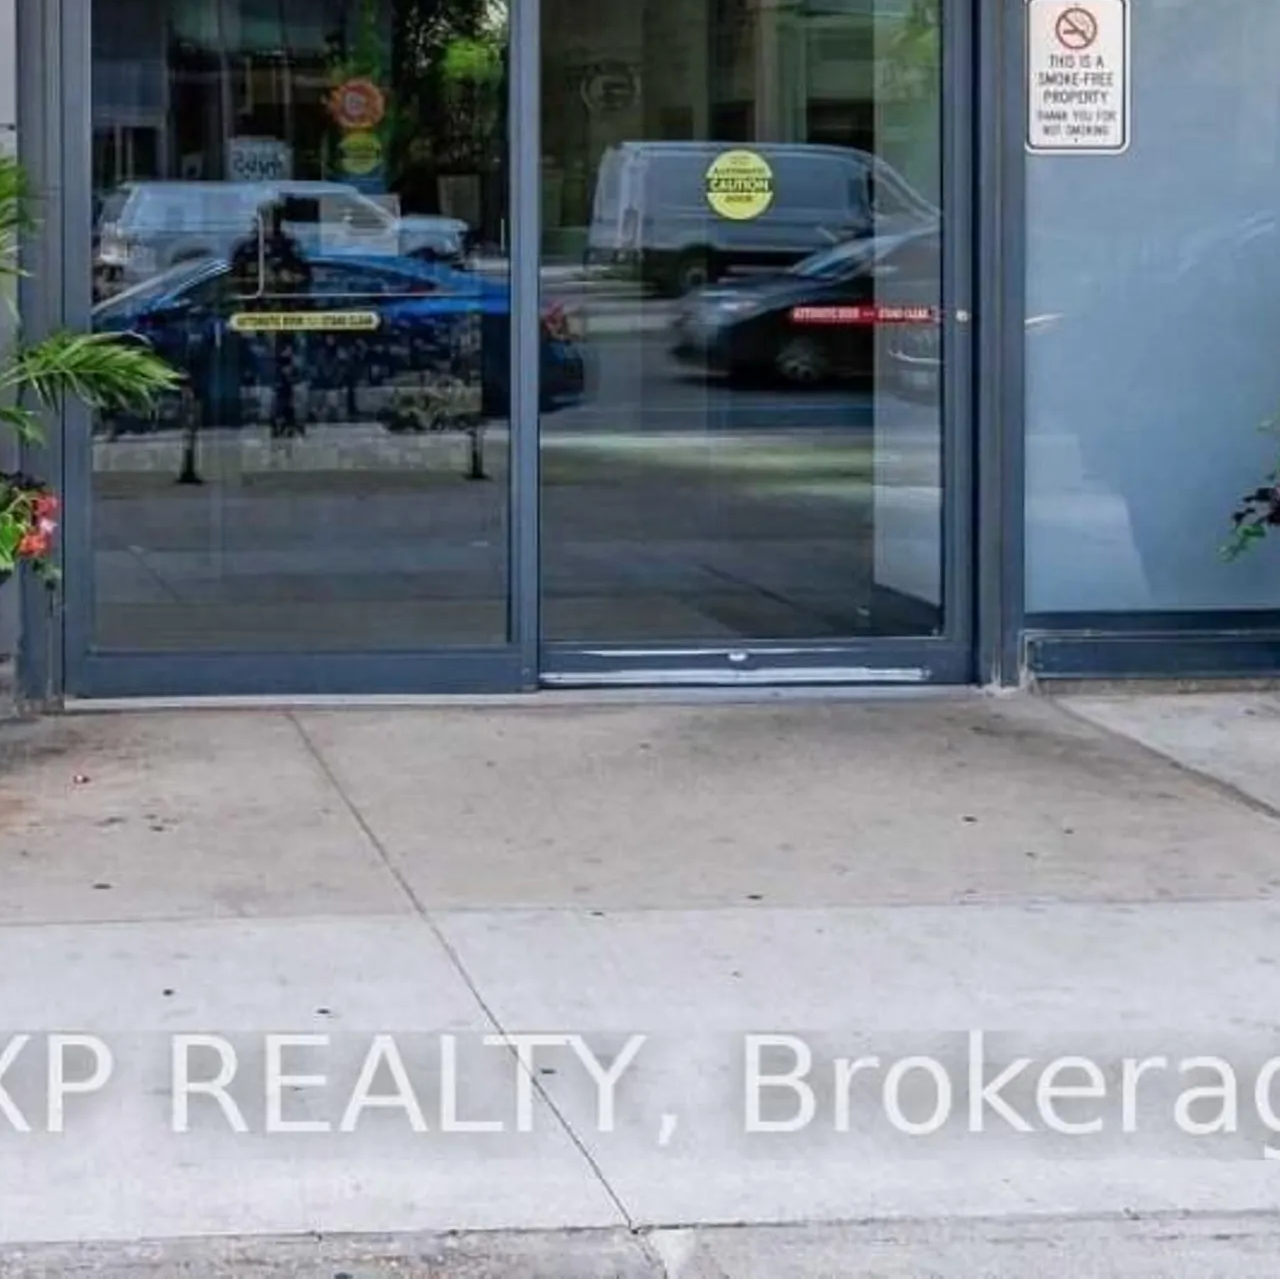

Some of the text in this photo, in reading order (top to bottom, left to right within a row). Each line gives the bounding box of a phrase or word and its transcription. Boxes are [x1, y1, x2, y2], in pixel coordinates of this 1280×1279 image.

[1049, 54, 1105, 69] THIS IS A
[1038, 71, 1115, 87] SMOKE-FREE
[1043, 89, 1109, 104] PROPERTY
[709, 178, 769, 192] CAUTION
